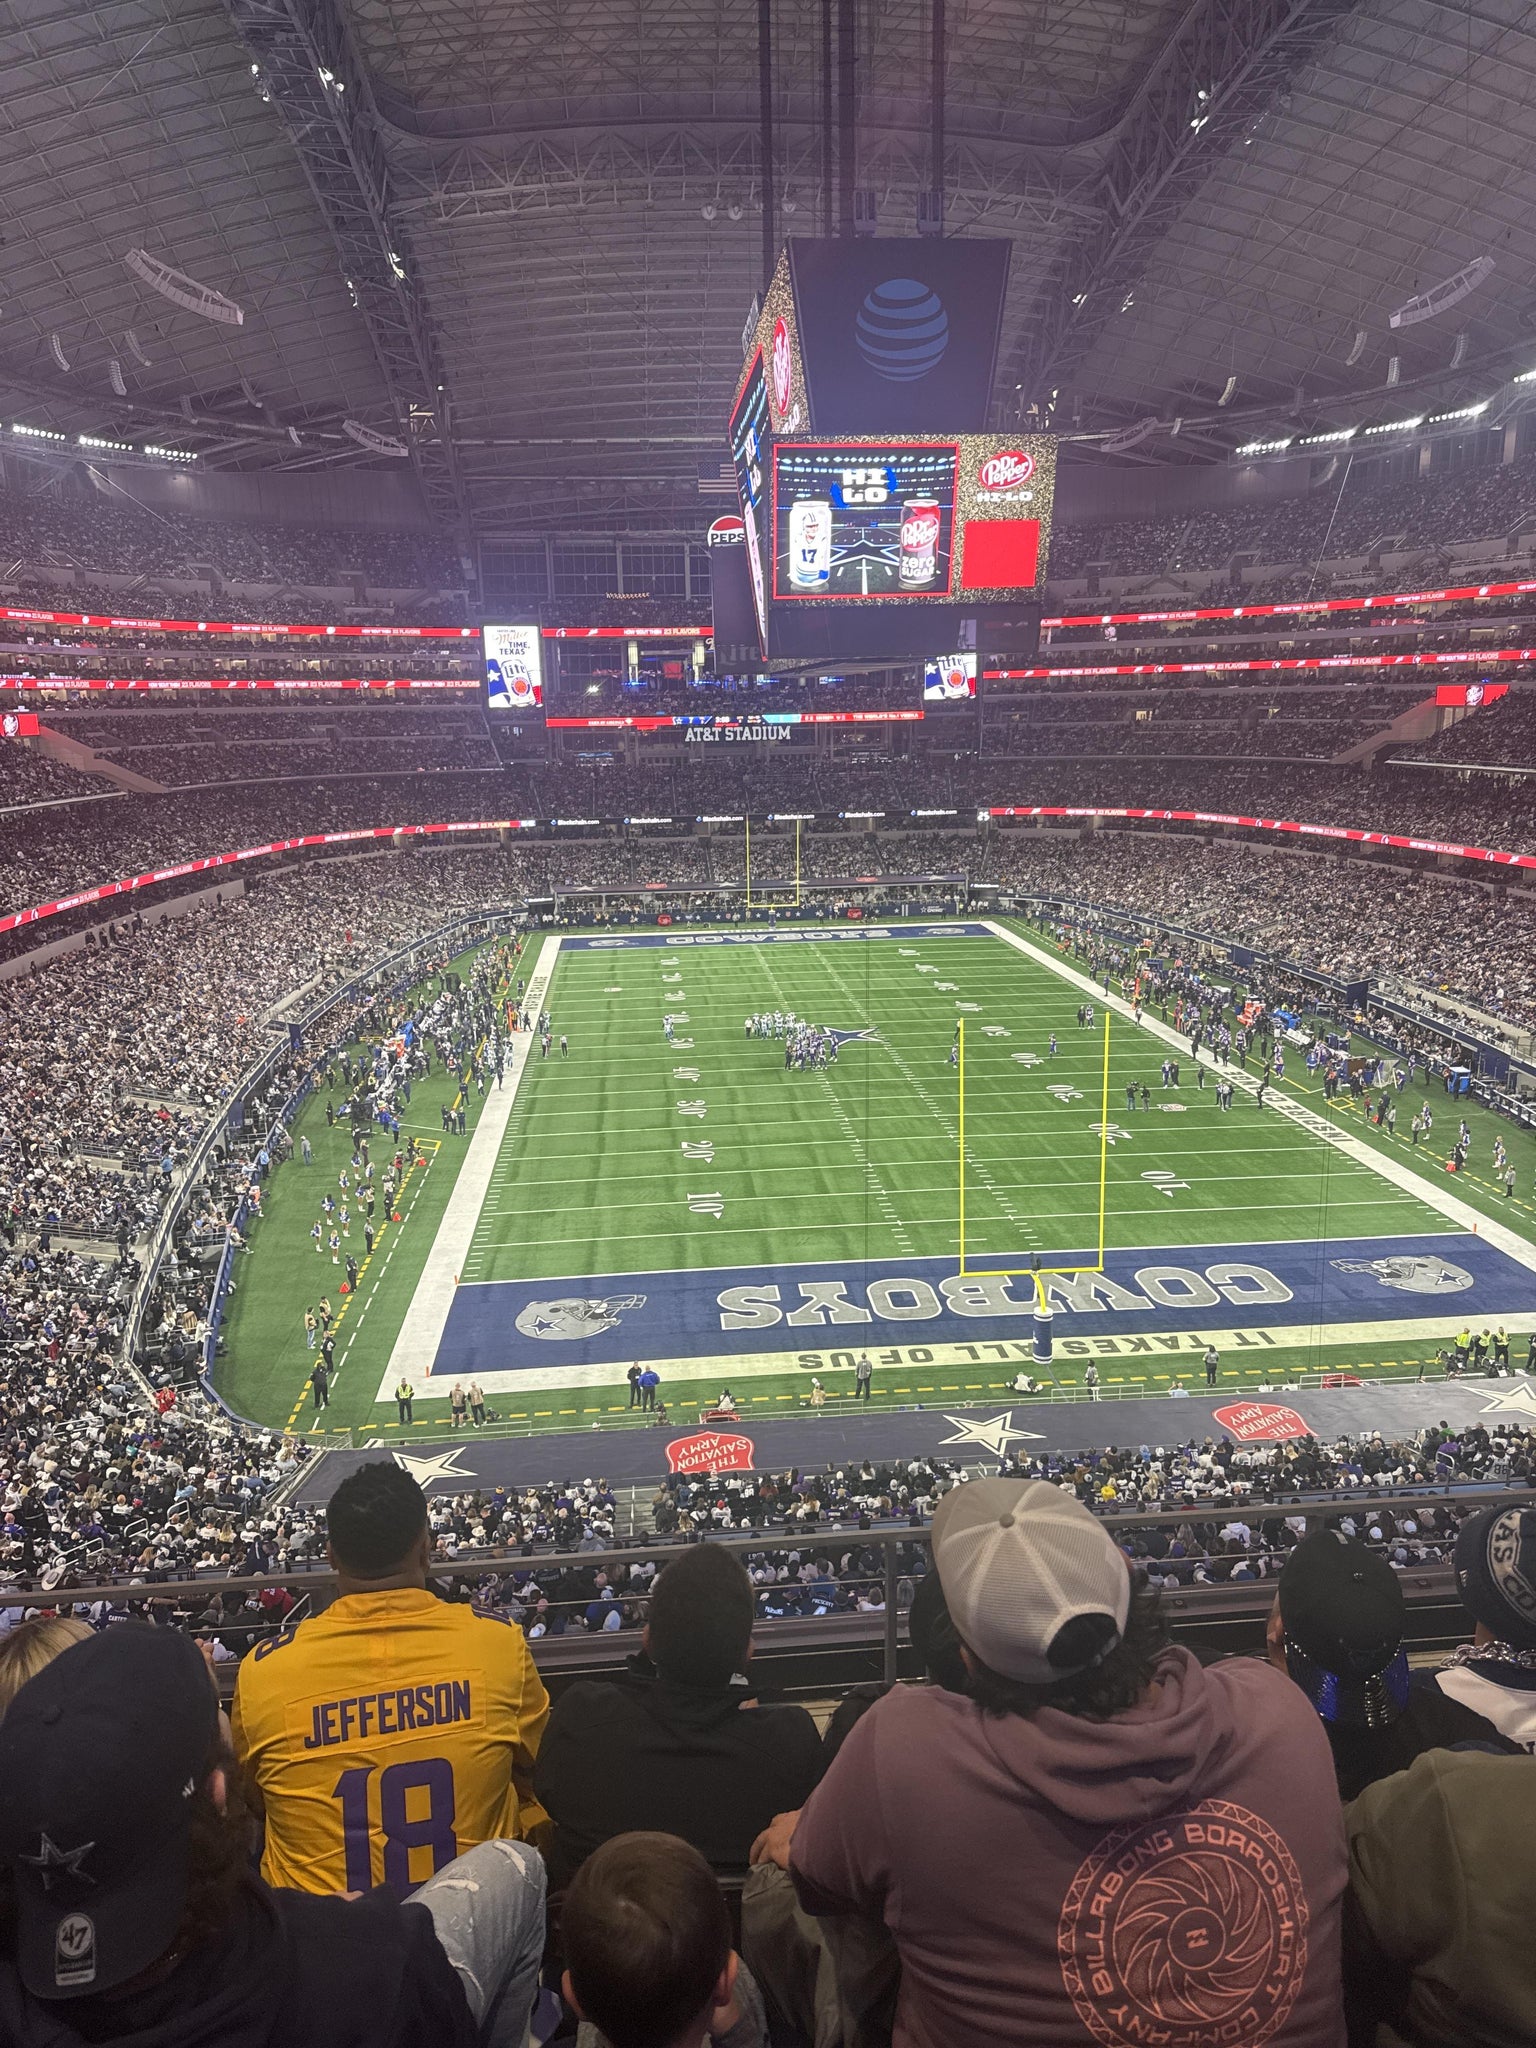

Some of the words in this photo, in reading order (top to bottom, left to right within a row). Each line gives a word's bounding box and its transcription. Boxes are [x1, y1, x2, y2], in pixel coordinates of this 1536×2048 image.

[1000, 456, 1017, 470] Dr
[842, 468, 886, 485] HI
[986, 459, 1029, 486] Pepper
[842, 487, 887, 502] LO
[914, 520, 931, 533] Dr
[802, 548, 817, 564] 17
[902, 556, 936, 568] zero
[902, 567, 934, 577] SUGAR
[504, 664, 525, 678] Lite
[685, 728, 722, 742] AT&T
[725, 726, 791, 742] STADIUM
[666, 929, 892, 945] COWBOYS
[672, 1066, 700, 1079] 40
[1046, 1084, 1084, 1099] 30
[676, 1100, 708, 1115] 30
[1088, 1122, 1133, 1140] 20
[1278, 1104, 1354, 1142] INSPIRE
[680, 1140, 715, 1159] 20
[1140, 1170, 1191, 1191] 10
[686, 1192, 724, 1213] 10
[716, 1263, 1294, 1330] COWBOYS
[1062, 1334, 1213, 1356] TAKES
[1233, 1331, 1277, 1346] IT
[798, 1350, 856, 1370] US
[881, 1346, 935, 1365] OF
[1230, 1405, 1262, 1426] ARMY
[1238, 1408, 1294, 1437] SALVATION
[1268, 1422, 1298, 1438] THE
[677, 1440, 747, 1471] SALVATION
[678, 1436, 720, 1458] ARMY
[706, 1454, 738, 1471] THE
[812, 1598, 834, 1608] PRESCOTT
[304, 1680, 471, 1749] JEFFERSON
[332, 1757, 458, 1899] 18
[1085, 1829, 1174, 1996] BILLABONG
[1107, 2004, 1260, 2044] COMPANY
